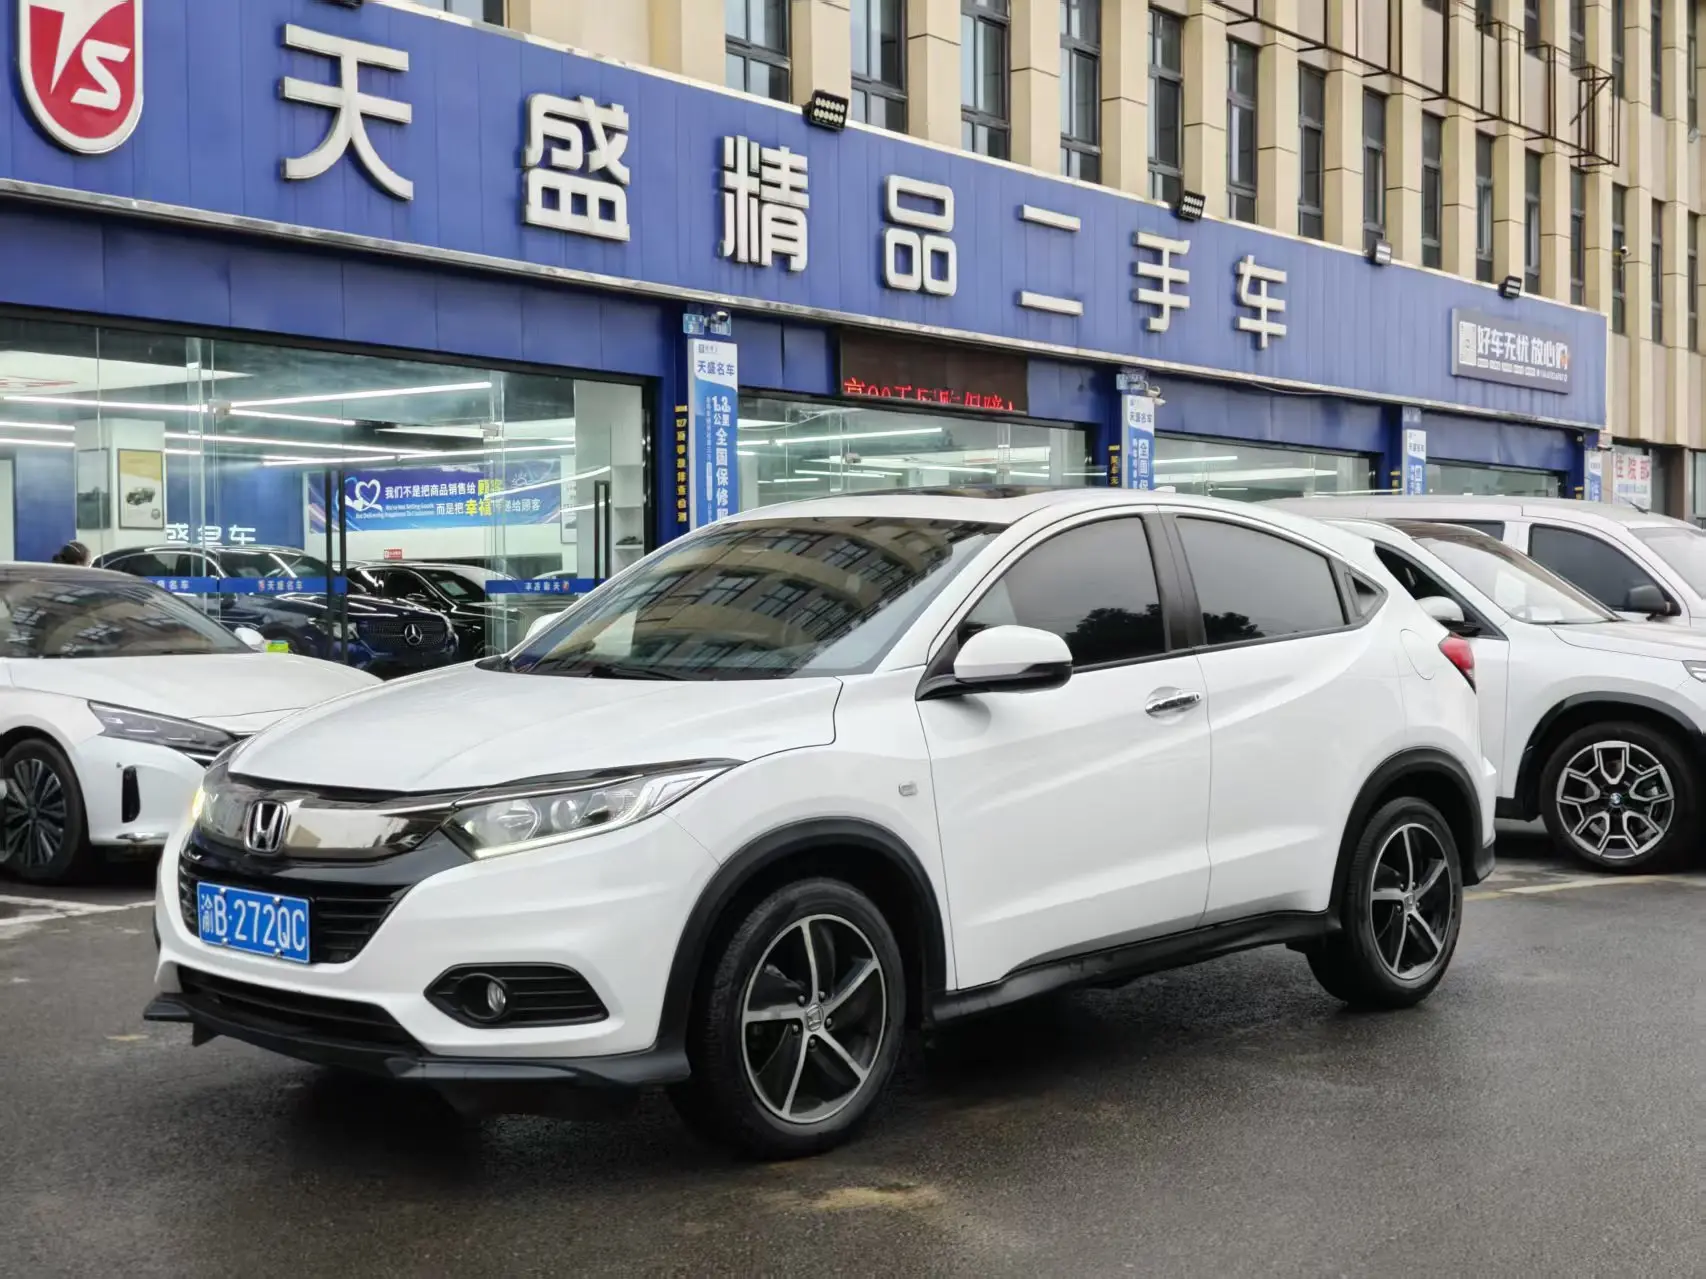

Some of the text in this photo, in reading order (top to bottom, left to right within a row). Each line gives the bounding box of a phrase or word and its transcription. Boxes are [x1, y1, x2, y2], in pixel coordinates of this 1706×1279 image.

[281, 23, 1288, 350] 天盛精品二手车
[1477, 325, 1528, 363] 好车无忧
[697, 359, 736, 378] 天盛名车
